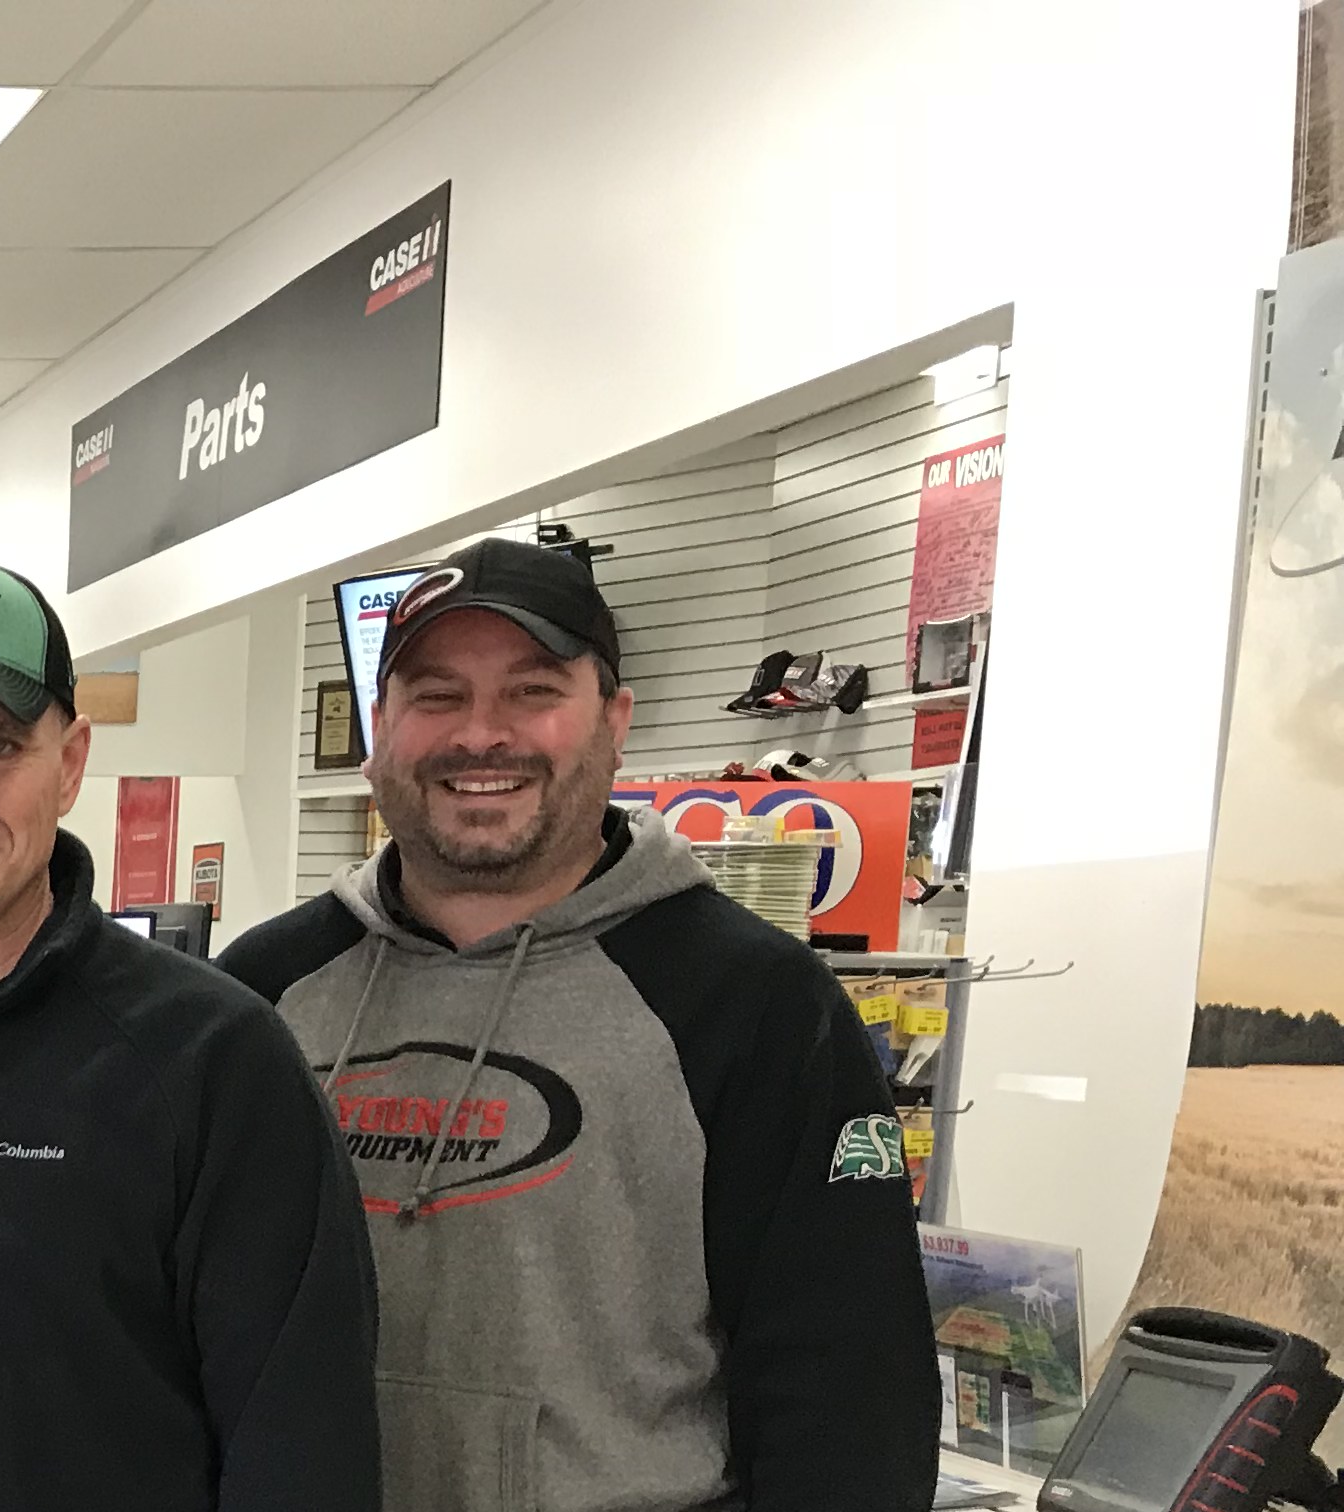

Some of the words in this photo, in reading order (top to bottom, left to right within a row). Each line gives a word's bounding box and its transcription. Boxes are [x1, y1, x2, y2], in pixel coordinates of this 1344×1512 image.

[370, 232, 423, 291] CASE
[76, 430, 104, 468] CASE
[179, 371, 266, 480] Parts
[928, 460, 951, 488] OUR
[955, 445, 1005, 488] VISION
